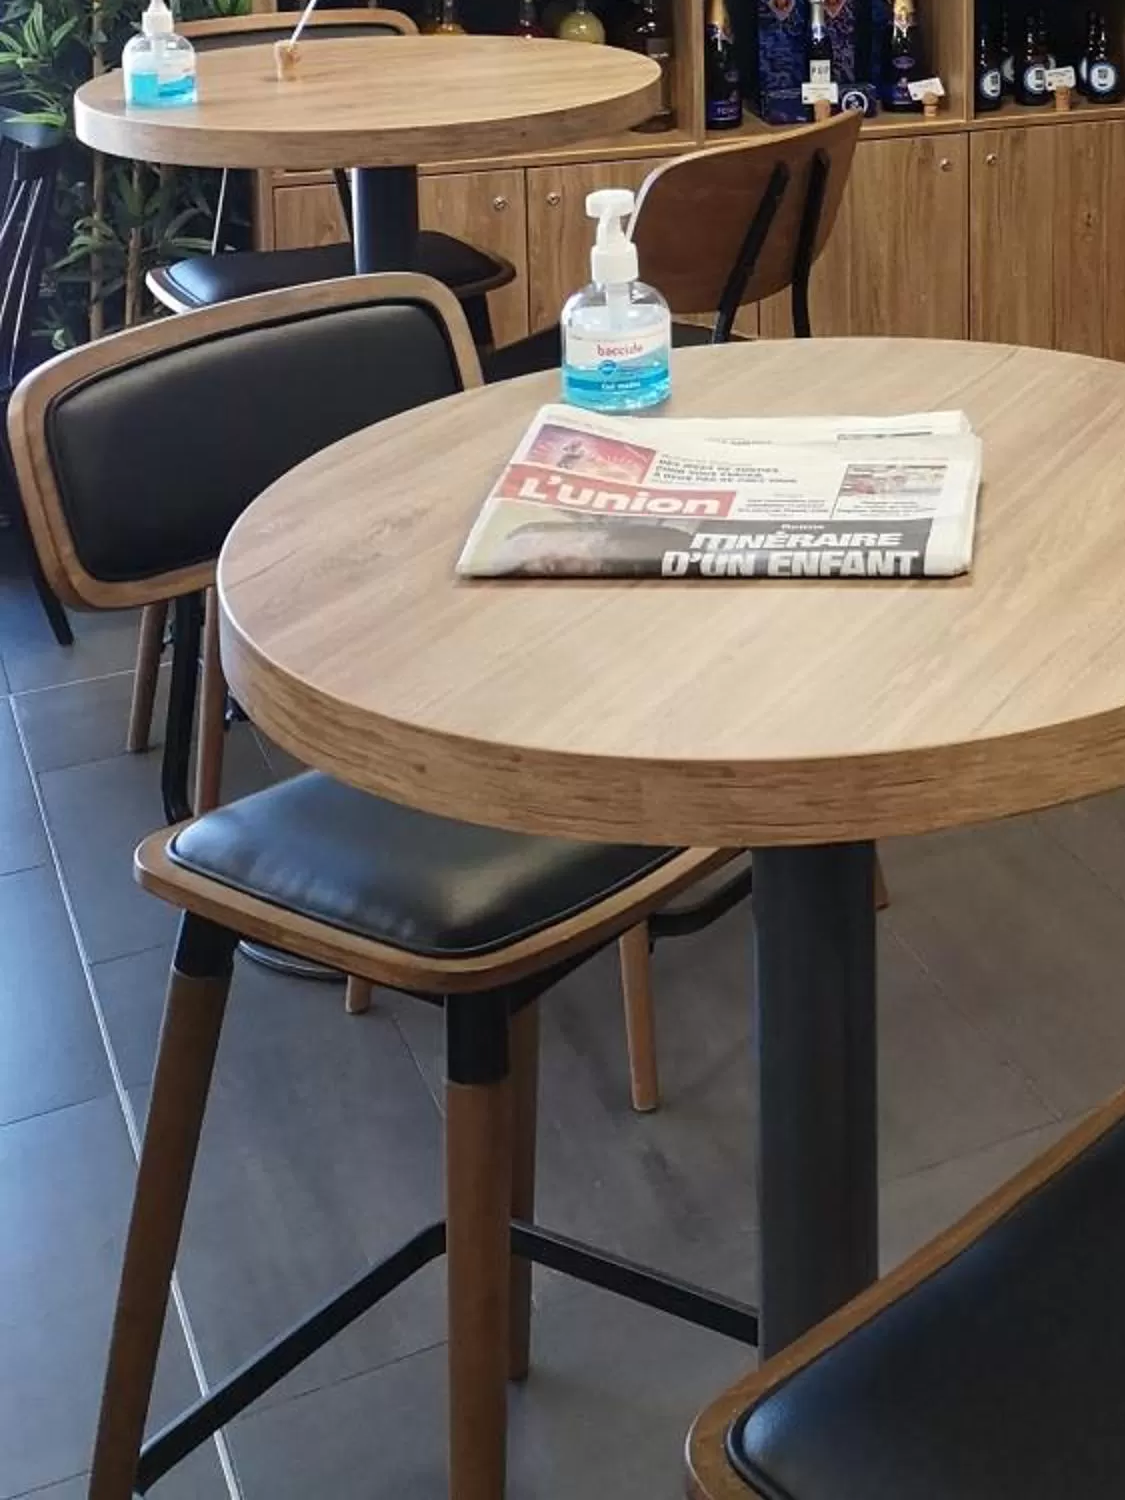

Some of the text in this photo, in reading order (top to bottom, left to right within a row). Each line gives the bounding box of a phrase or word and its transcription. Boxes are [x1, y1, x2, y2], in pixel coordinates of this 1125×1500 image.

[517, 476, 721, 515] L'union
[690, 531, 904, 549] ITINÉRAIRE
[661, 550, 919, 577] D'UN ENFANT
